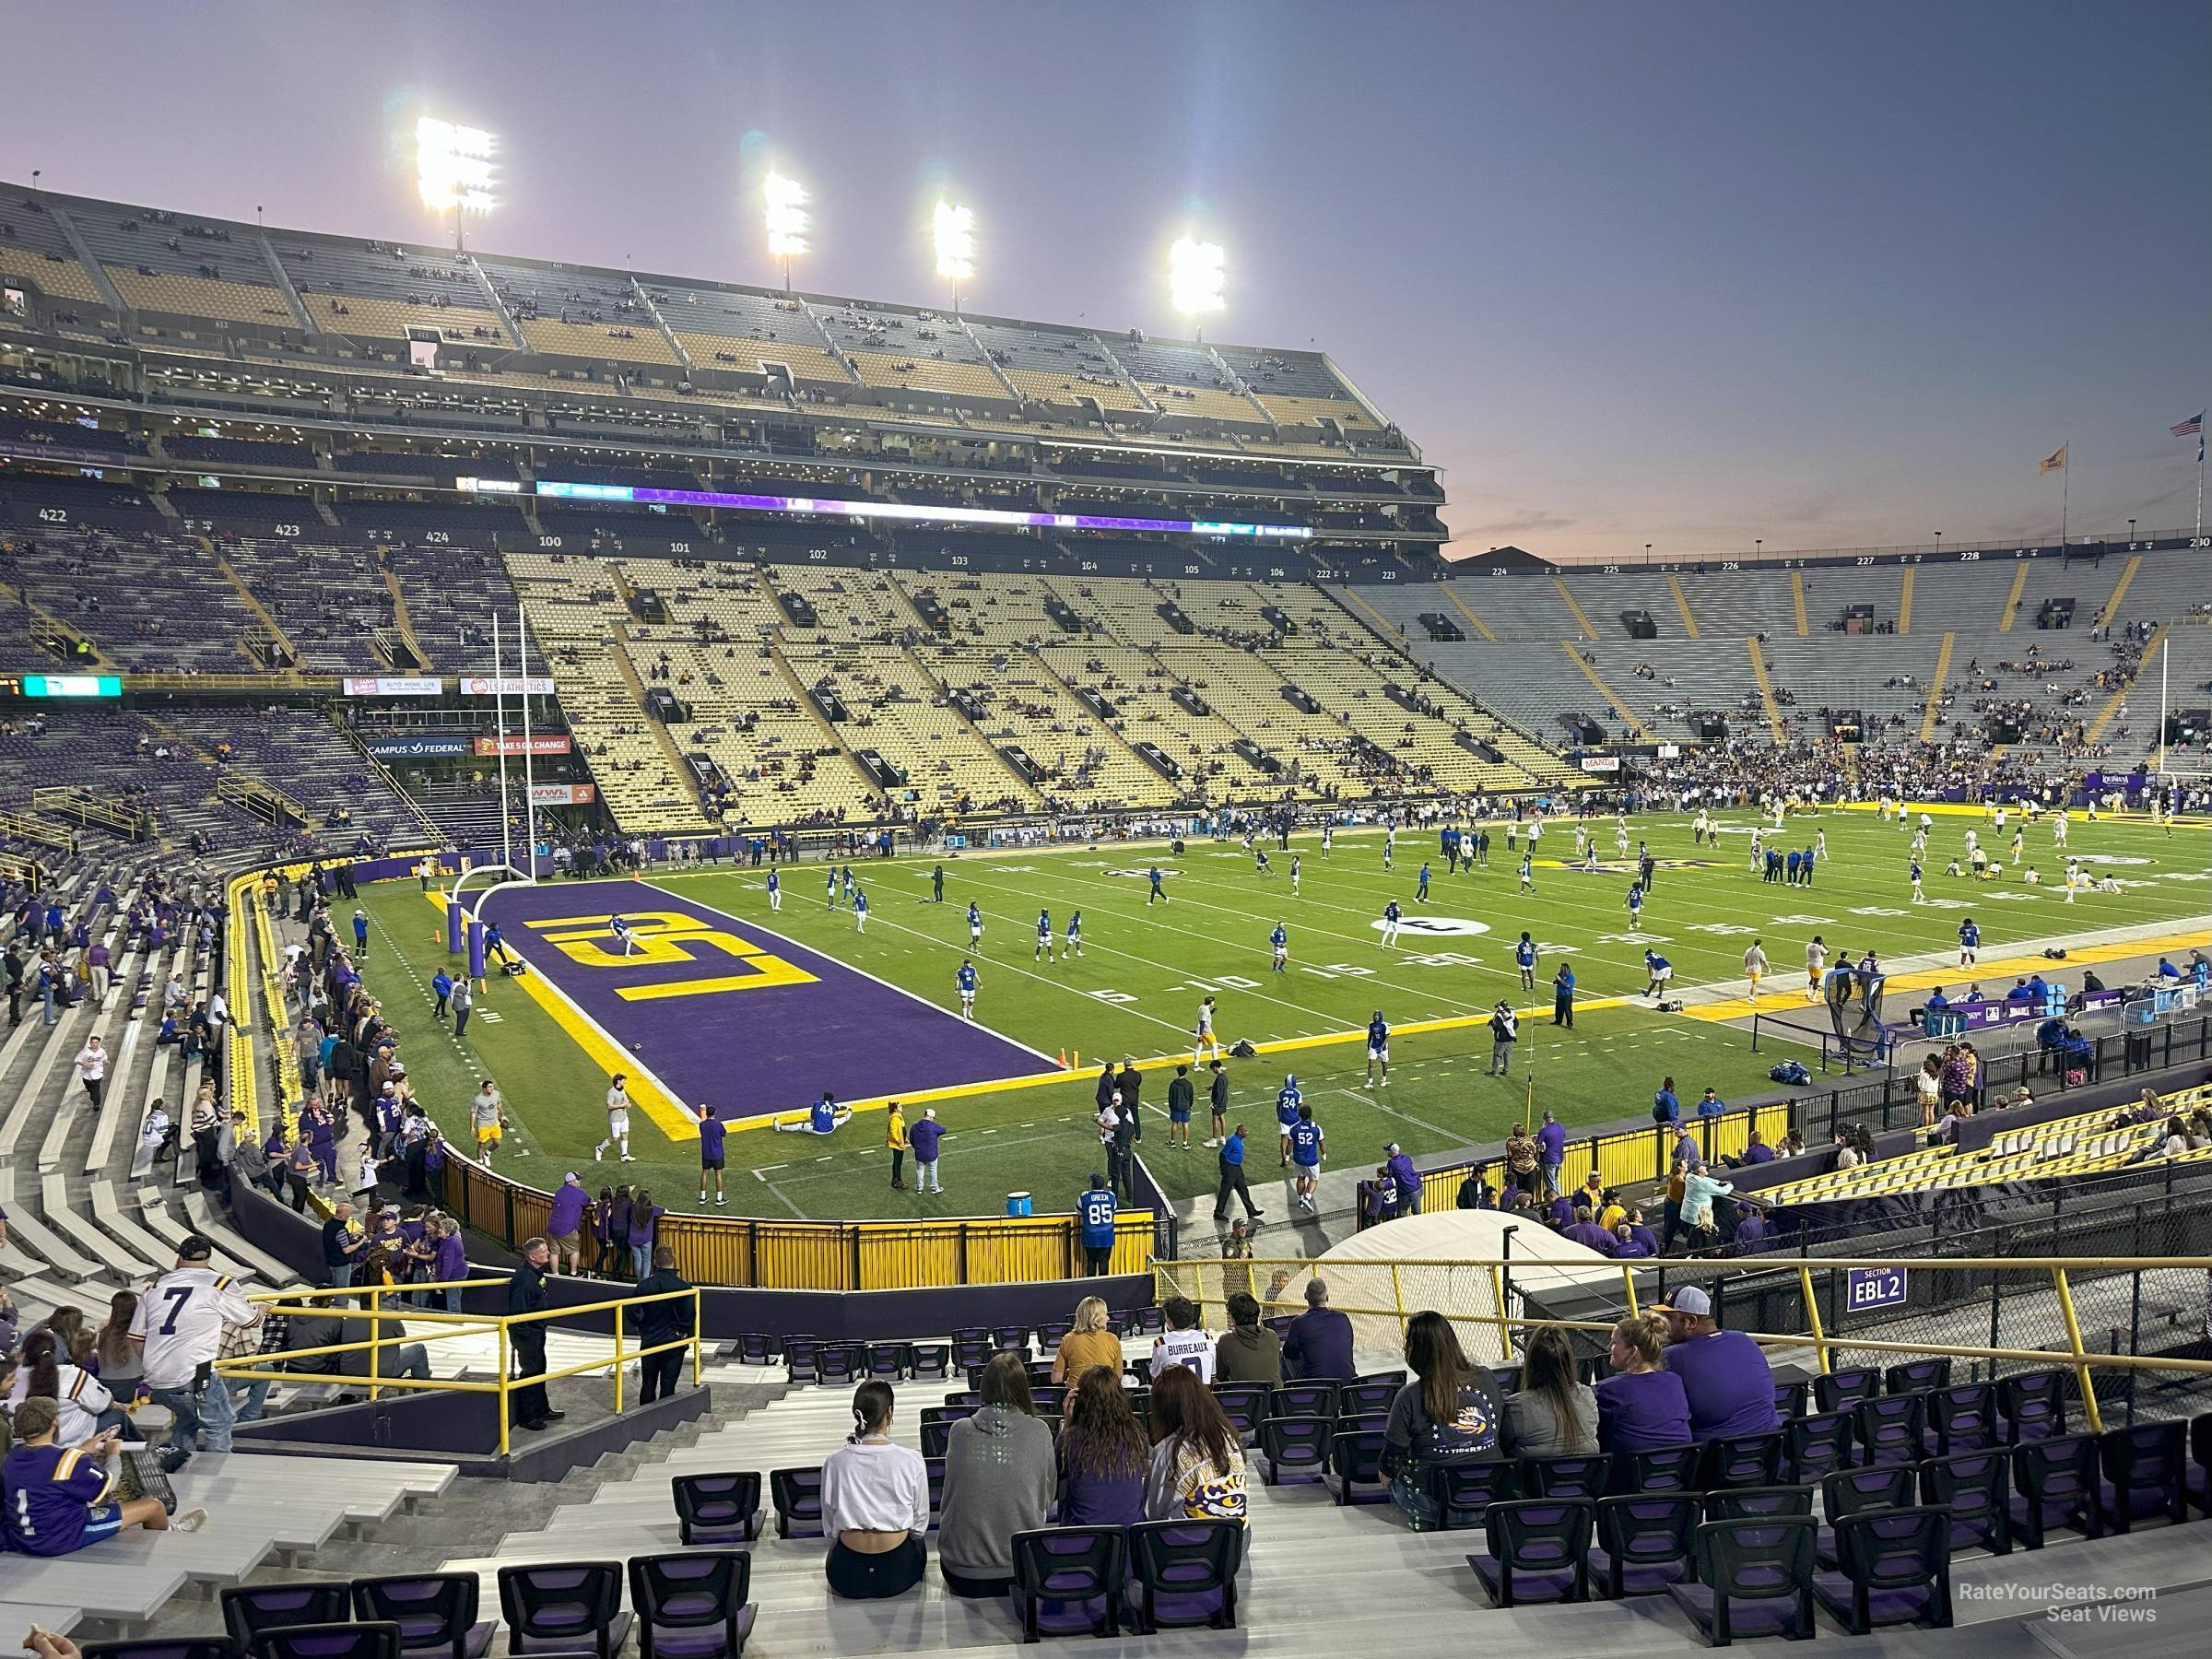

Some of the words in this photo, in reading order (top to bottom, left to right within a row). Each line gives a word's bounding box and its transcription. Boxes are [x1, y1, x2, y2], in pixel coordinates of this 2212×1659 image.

[39, 509, 67, 523] 422
[275, 524, 300, 537] 423
[426, 531, 450, 544] 424
[539, 535, 562, 547] 100
[670, 542, 690, 553] 101
[809, 549, 828, 560] 102
[1960, 551, 1980, 561] 228
[952, 556, 968, 566] 103
[1081, 561, 1098, 571] 104
[1722, 561, 1739, 571] 226
[1856, 556, 1875, 566] 227
[1184, 565, 1199, 574] 105
[1270, 568, 1285, 577] 106
[1316, 570, 1331, 579] 222
[1491, 567, 1508, 576] 224
[1603, 565, 1619, 574] 225
[1382, 571, 1396, 580] 223
[368, 746, 407, 755] CAMPUS
[424, 744, 465, 753] FEDERAL
[535, 740, 566, 749] CHANGE
[1585, 759, 1616, 769] MANDA
[1300, 963, 1379, 979] 15
[1184, 975, 1265, 992] 10
[1087, 989, 1141, 1004] 5
[1282, 1097, 1296, 1109] 24
[1298, 1132, 1313, 1145] 52
[1090, 1194, 1109, 1202] GREEN
[1383, 1188, 1397, 1205] 32
[1088, 1204, 1113, 1225] 85
[1865, 1267, 1891, 1279] SECTION
[1855, 1279, 1886, 1303] EBL
[1888, 1276, 1900, 1298] 2
[159, 1287, 194, 1335] 7
[1167, 1341, 1209, 1357] BURREAUX
[1451, 1445, 1483, 1454] TIGERS
